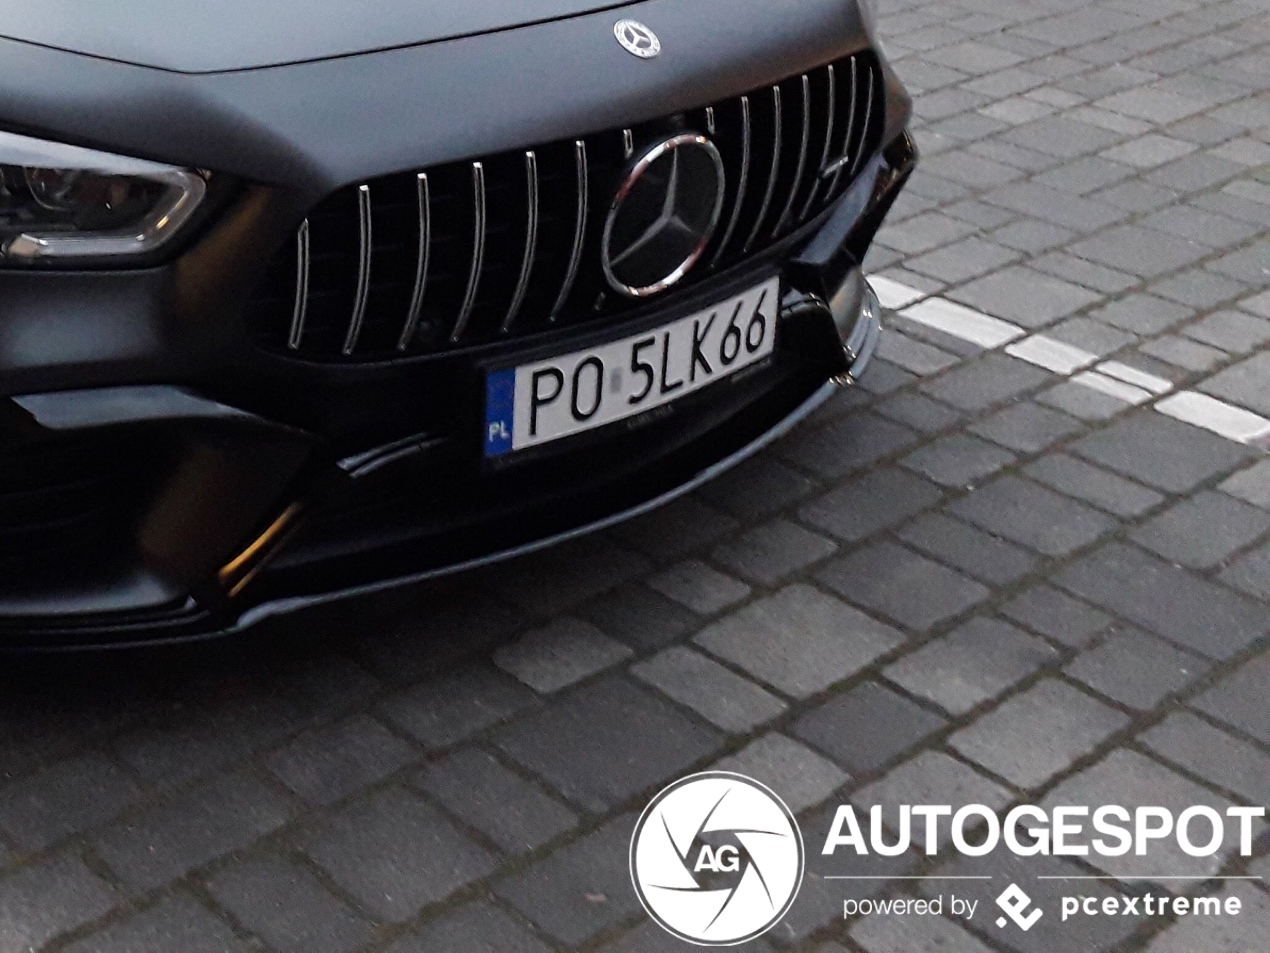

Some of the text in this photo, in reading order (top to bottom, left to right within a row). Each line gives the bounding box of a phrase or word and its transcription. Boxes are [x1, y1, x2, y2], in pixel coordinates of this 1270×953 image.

[529, 289, 767, 436] PO 5LK66
[488, 421, 510, 442] PL
